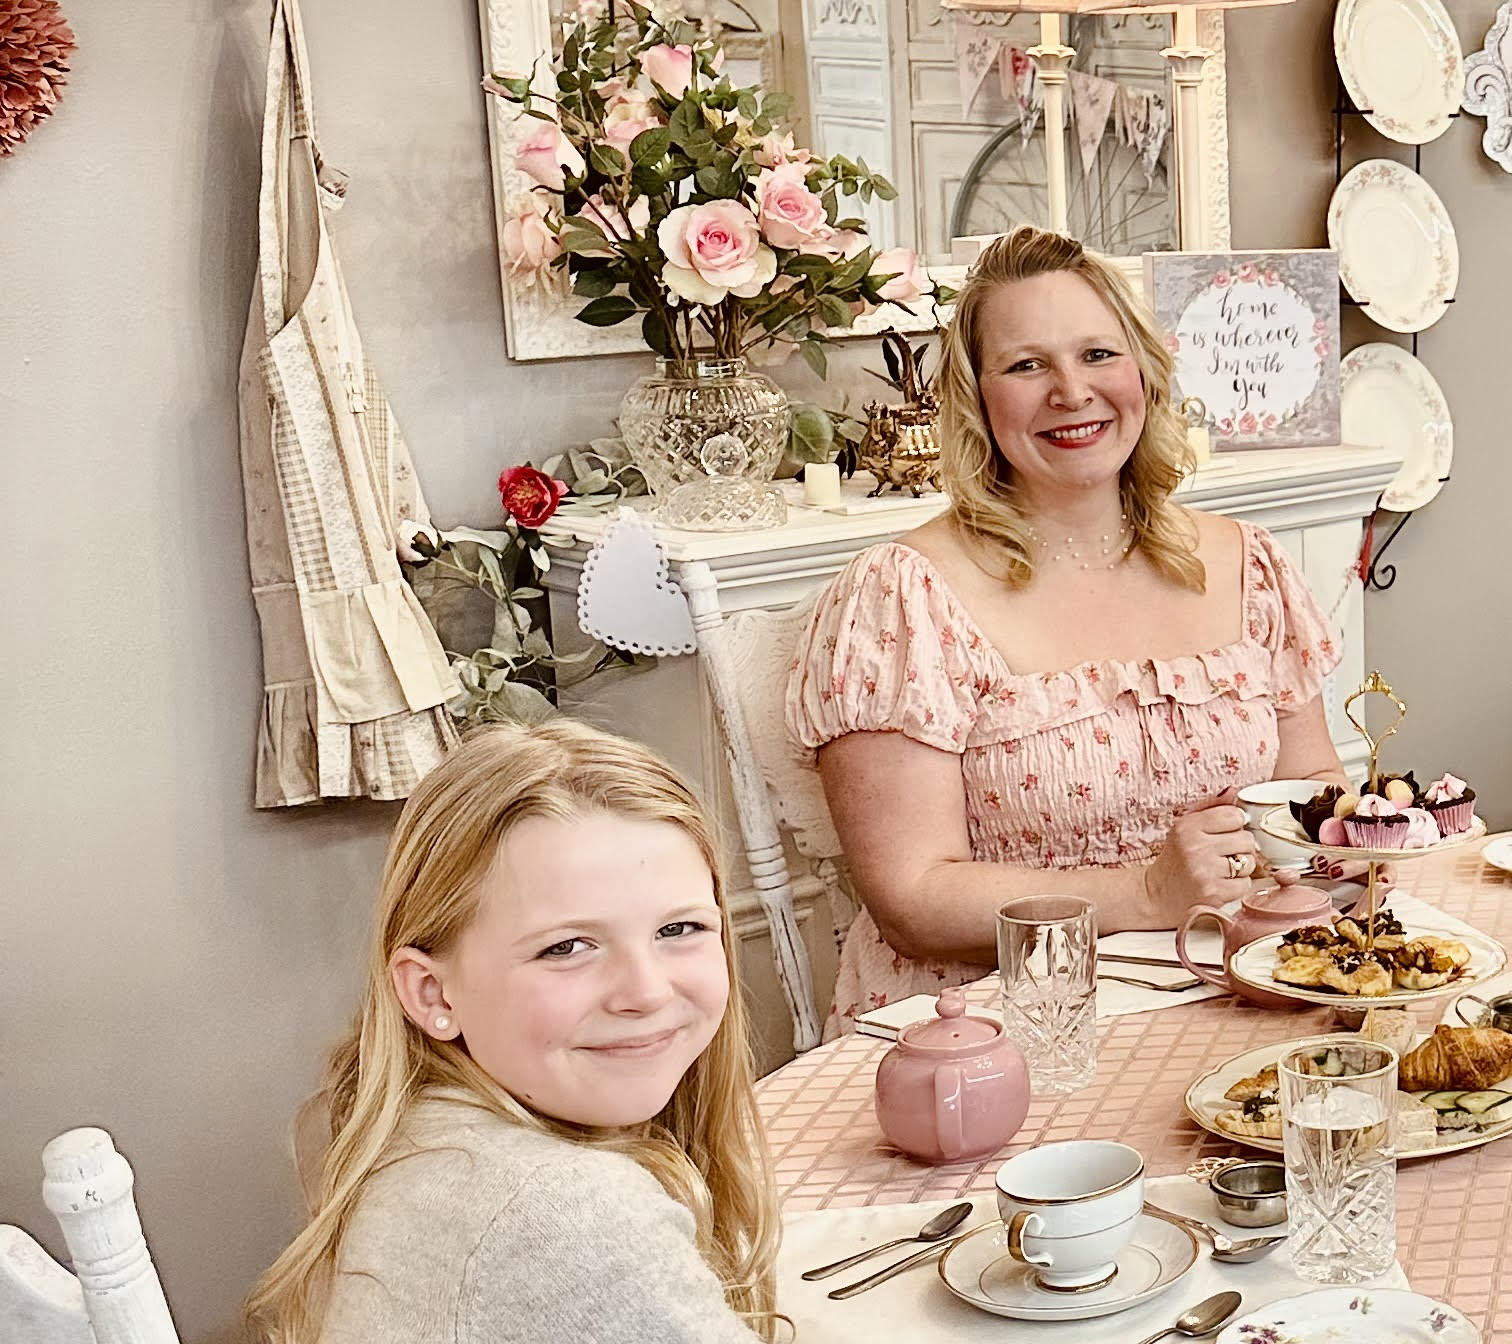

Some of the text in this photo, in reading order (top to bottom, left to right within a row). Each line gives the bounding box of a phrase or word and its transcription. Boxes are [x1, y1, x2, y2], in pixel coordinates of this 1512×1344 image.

[1218, 287, 1278, 323] home
[1192, 323, 1299, 349] is wherever
[1208, 349, 1284, 375] I'm with
